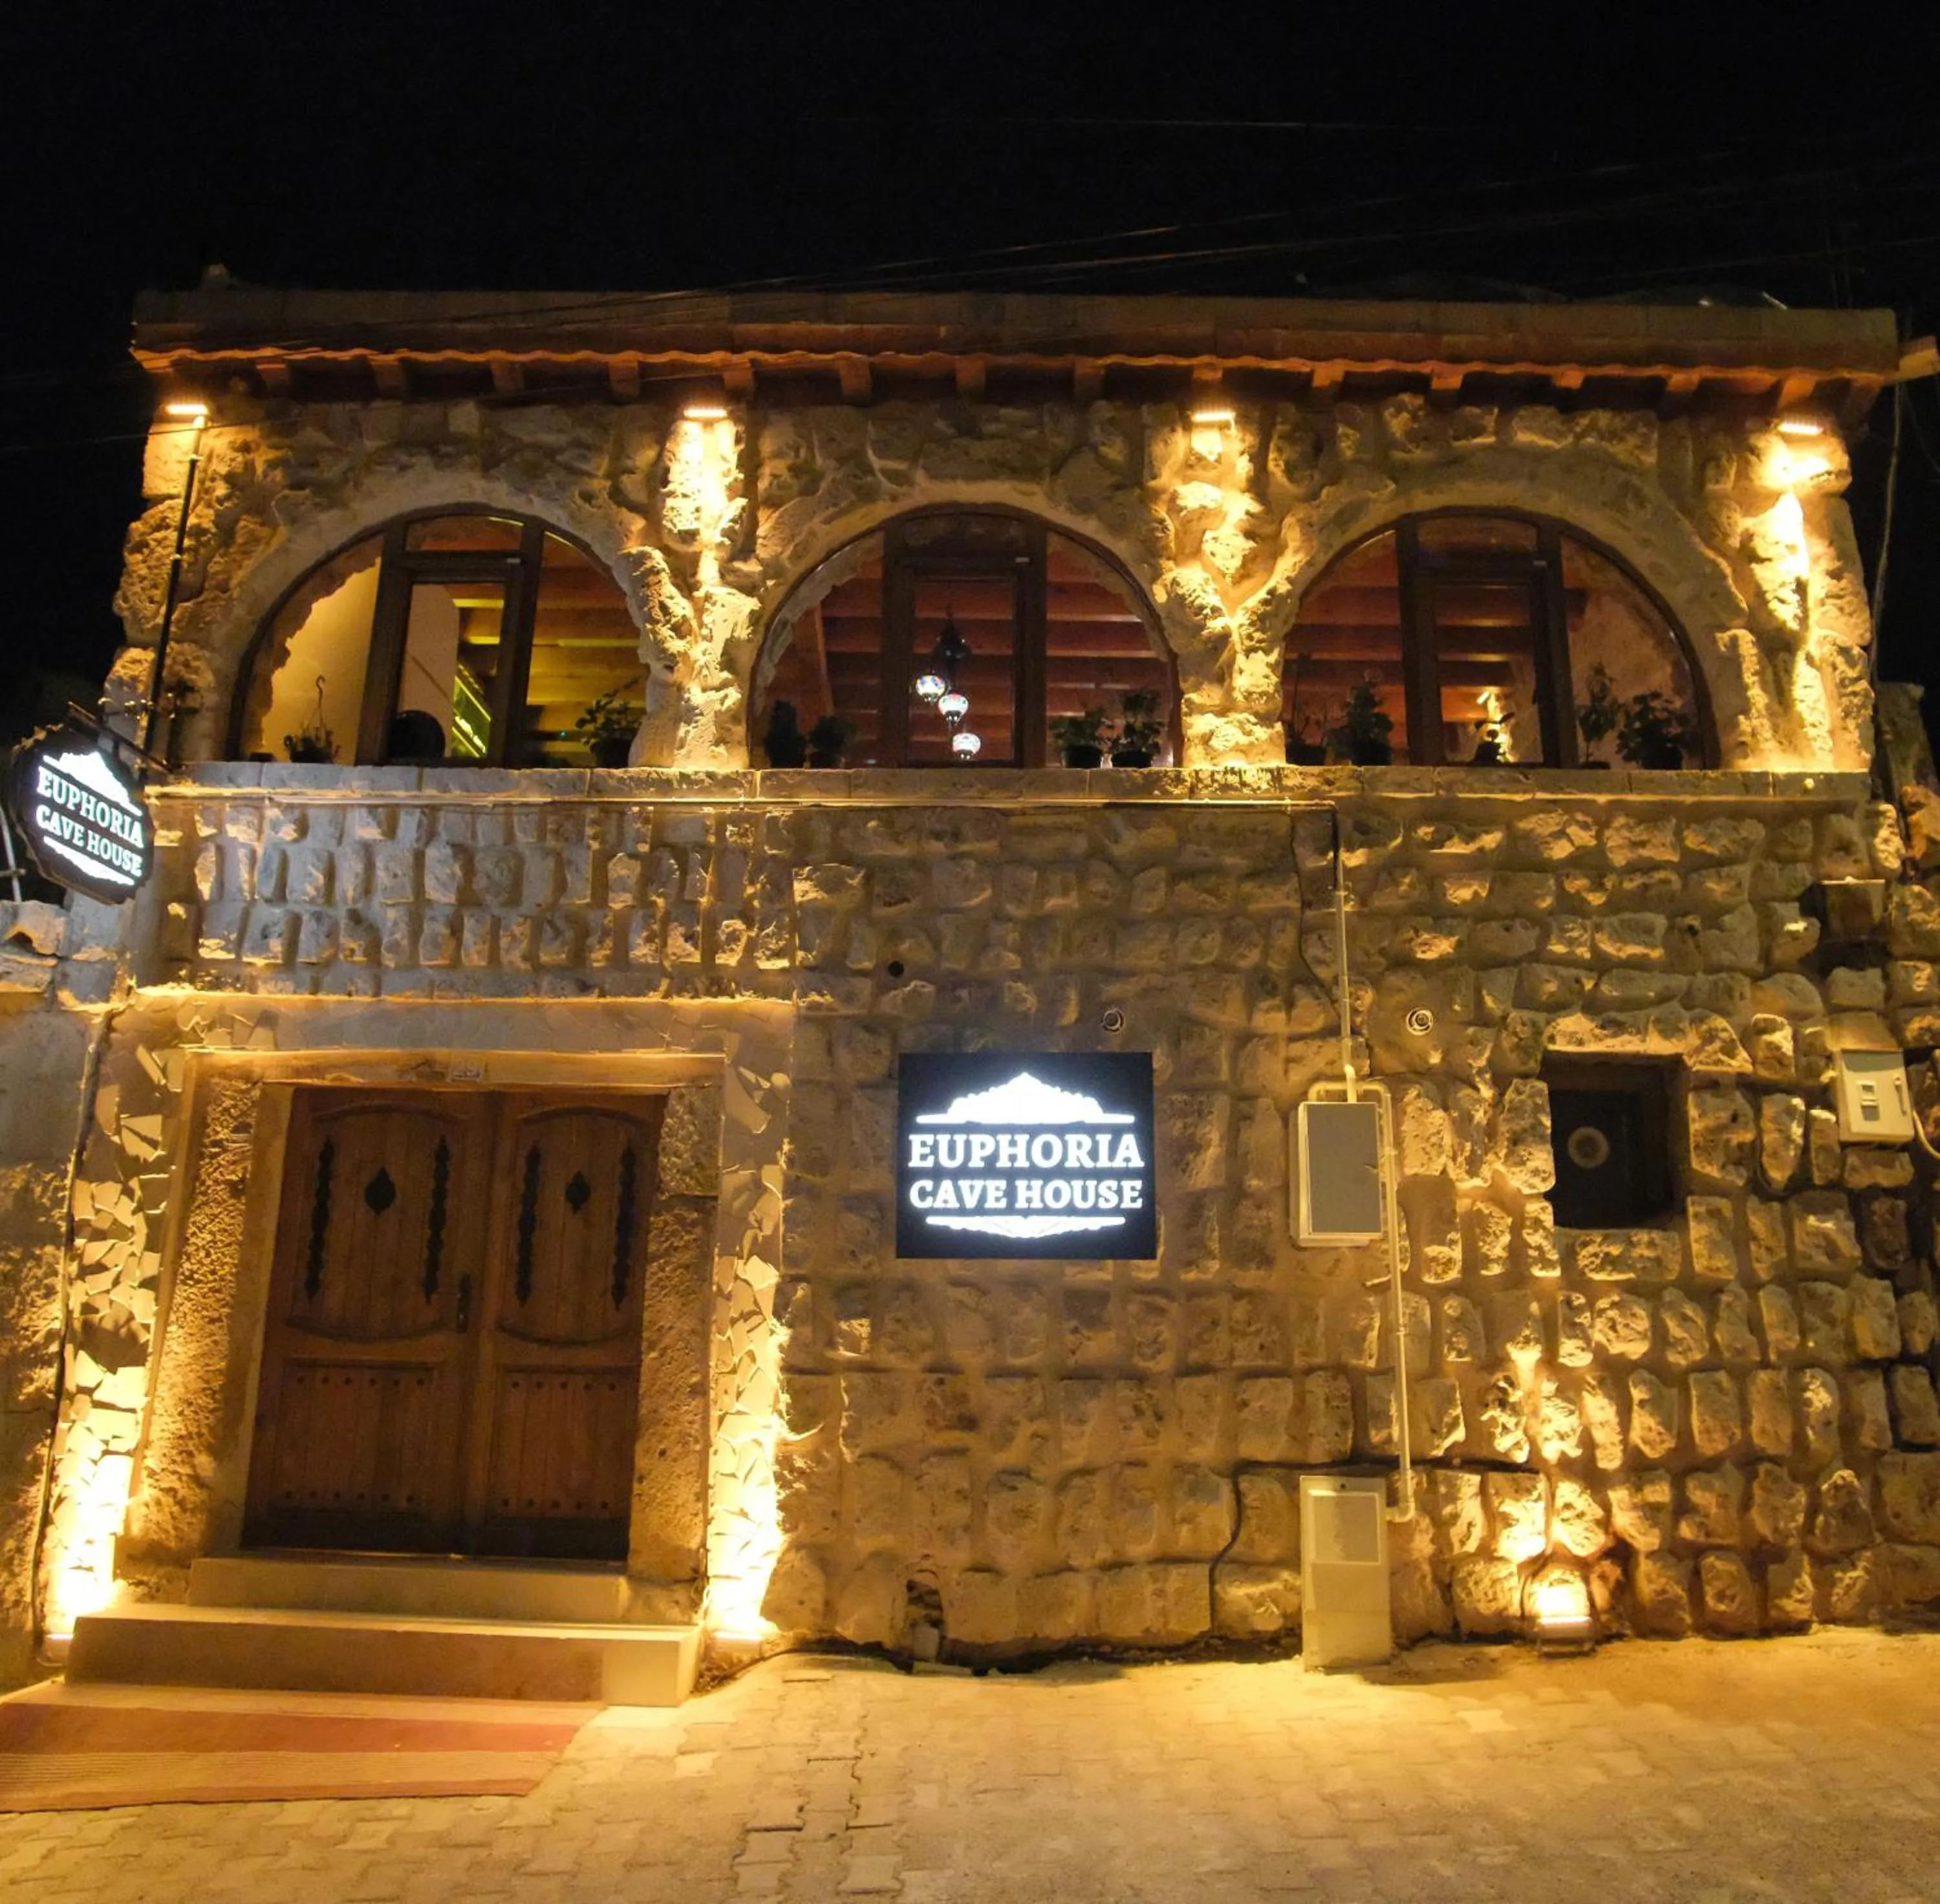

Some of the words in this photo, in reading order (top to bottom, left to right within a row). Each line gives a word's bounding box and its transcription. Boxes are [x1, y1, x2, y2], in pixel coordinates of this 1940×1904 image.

[36, 766, 144, 849] EUPHORIA
[36, 805, 85, 848] CAVE
[87, 829, 143, 878] HOUSE
[908, 1133, 1145, 1168] EUPHORIA
[909, 1179, 1008, 1209] CAVE
[1015, 1179, 1143, 1209] HOUSE
